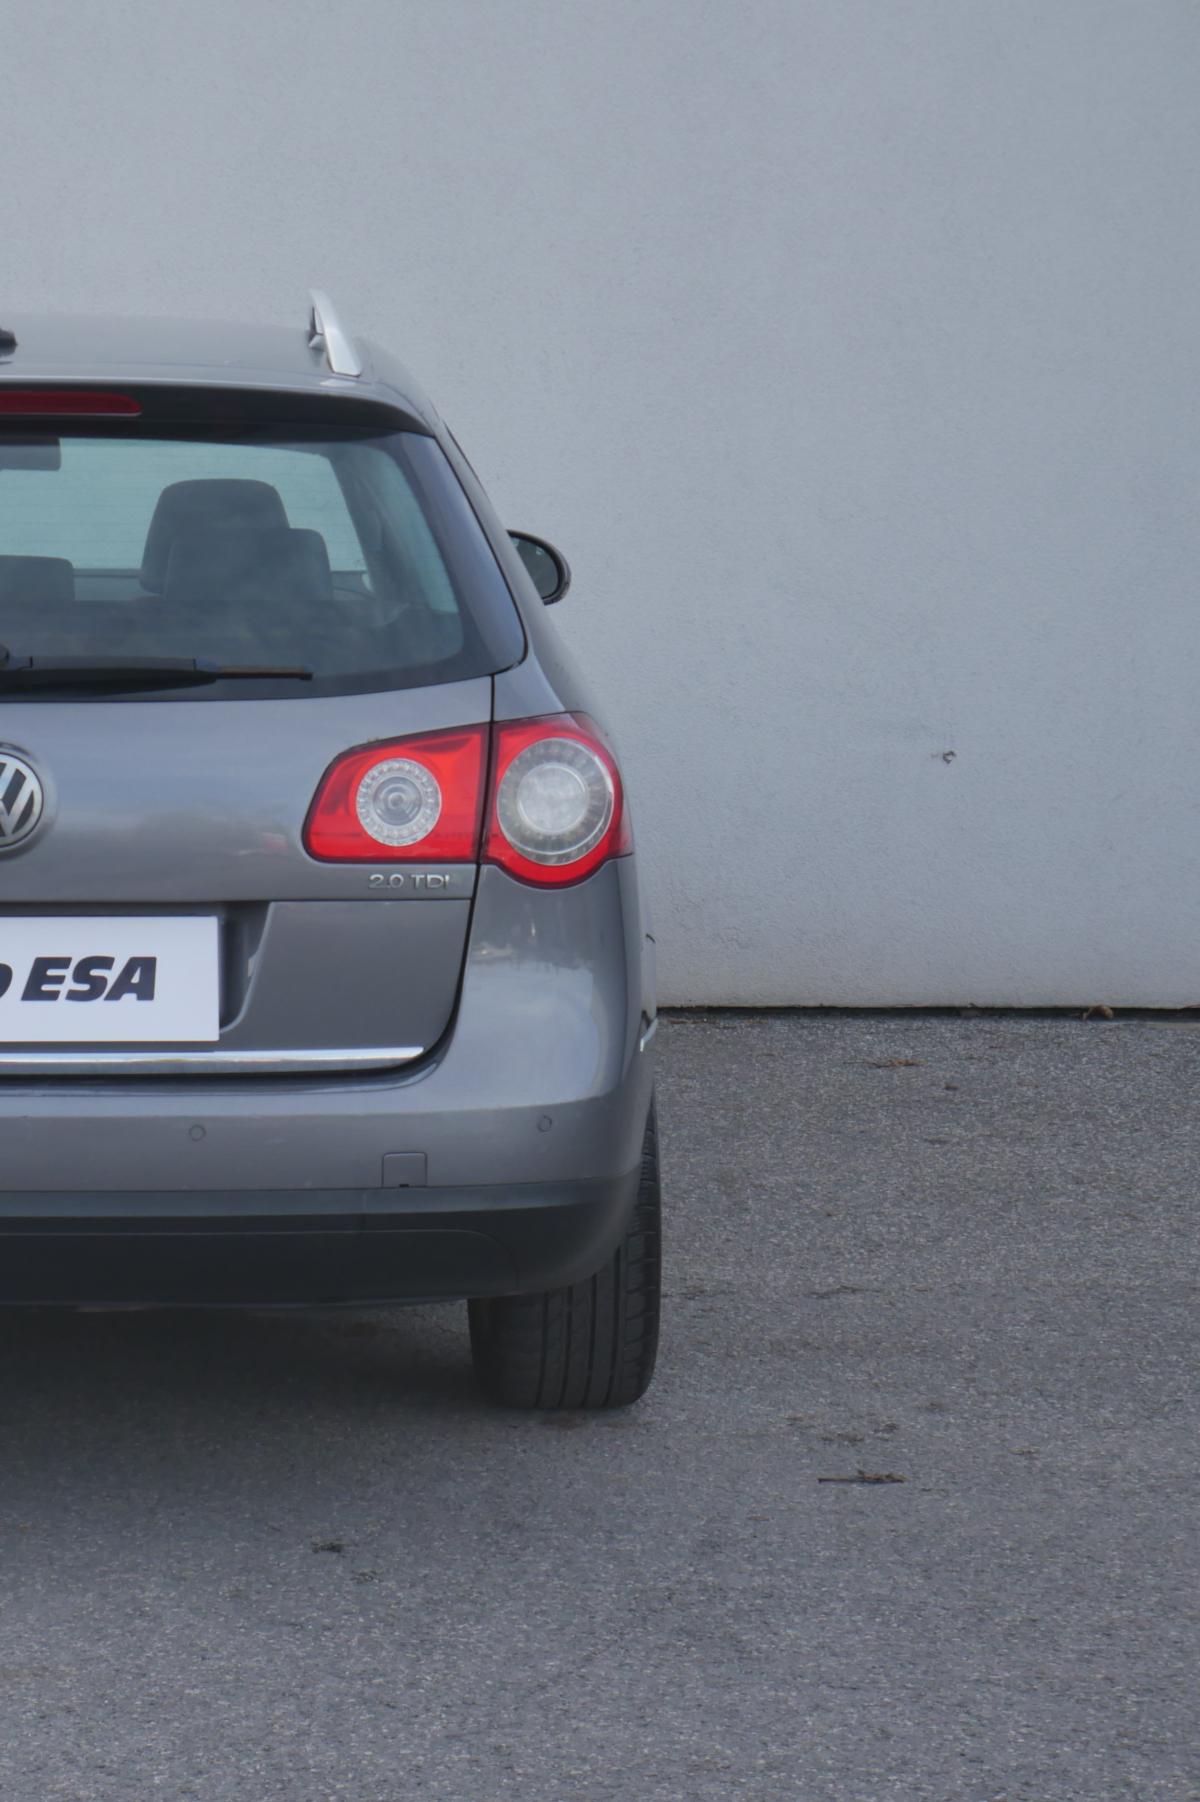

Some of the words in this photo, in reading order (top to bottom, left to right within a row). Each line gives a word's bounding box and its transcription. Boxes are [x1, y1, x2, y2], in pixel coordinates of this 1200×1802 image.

[368, 873, 405, 889] 2.0
[410, 873, 450, 889] TDI
[20, 955, 157, 1002] ESA
